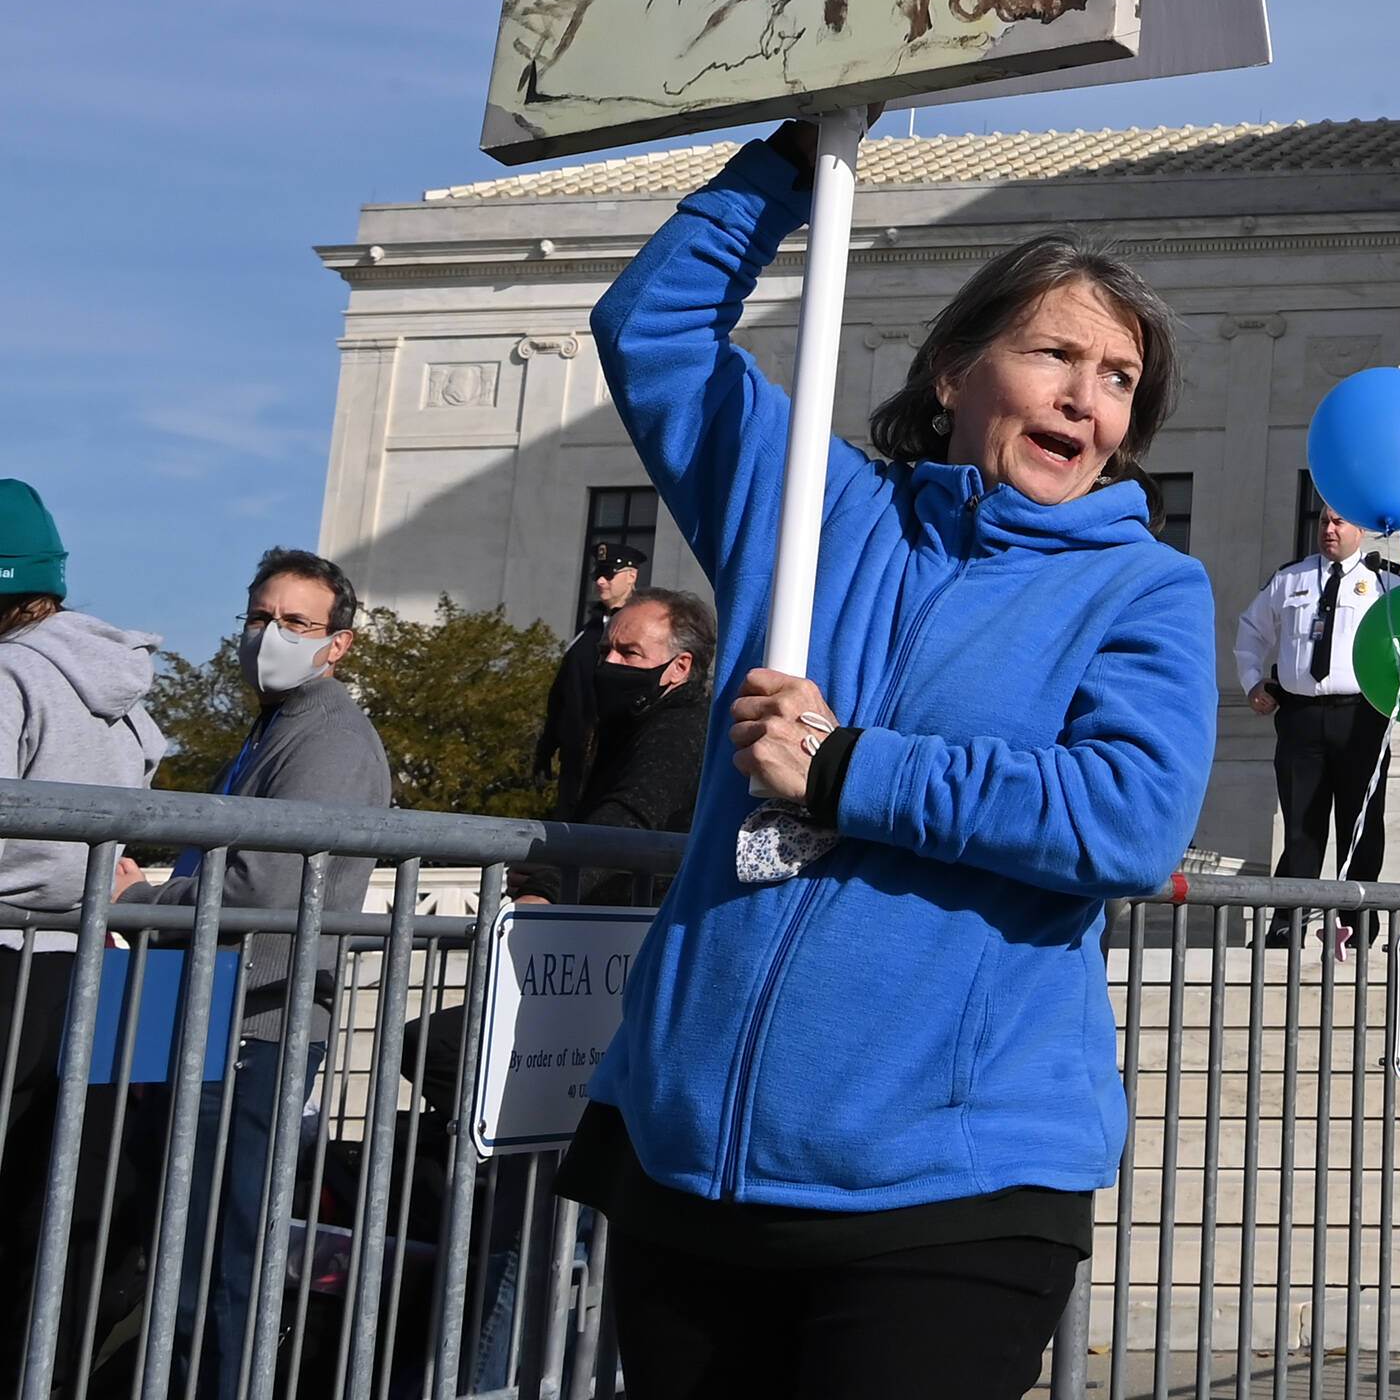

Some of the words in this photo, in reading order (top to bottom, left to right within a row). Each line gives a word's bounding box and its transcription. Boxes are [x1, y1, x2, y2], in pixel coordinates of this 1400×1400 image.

[520, 953, 592, 996] AREA
[509, 1050, 523, 1072] By
[526, 1049, 553, 1069] order
[556, 1048, 568, 1067] of
[571, 1047, 586, 1066] the
